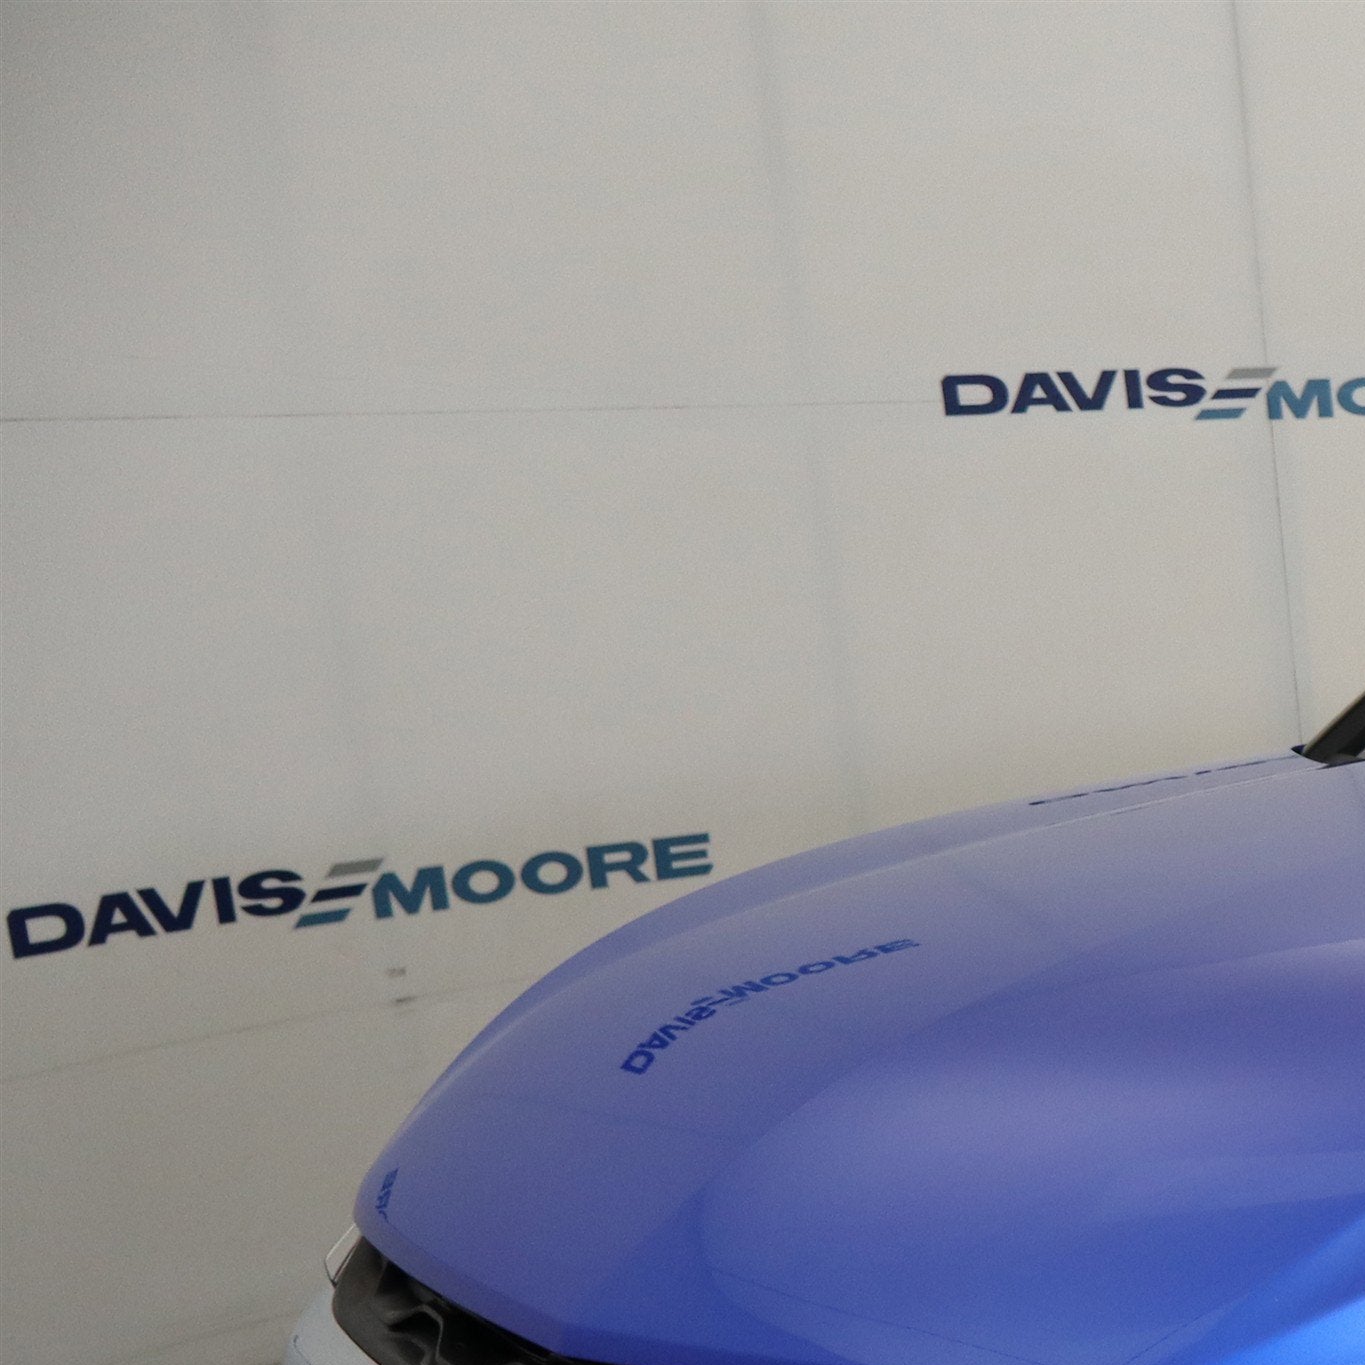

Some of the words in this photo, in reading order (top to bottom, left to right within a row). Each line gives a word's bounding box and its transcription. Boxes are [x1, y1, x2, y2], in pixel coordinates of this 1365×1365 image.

[940, 367, 1208, 418] DAVIS
[6, 868, 307, 959] DAVIS
[370, 832, 714, 921] MOORE
